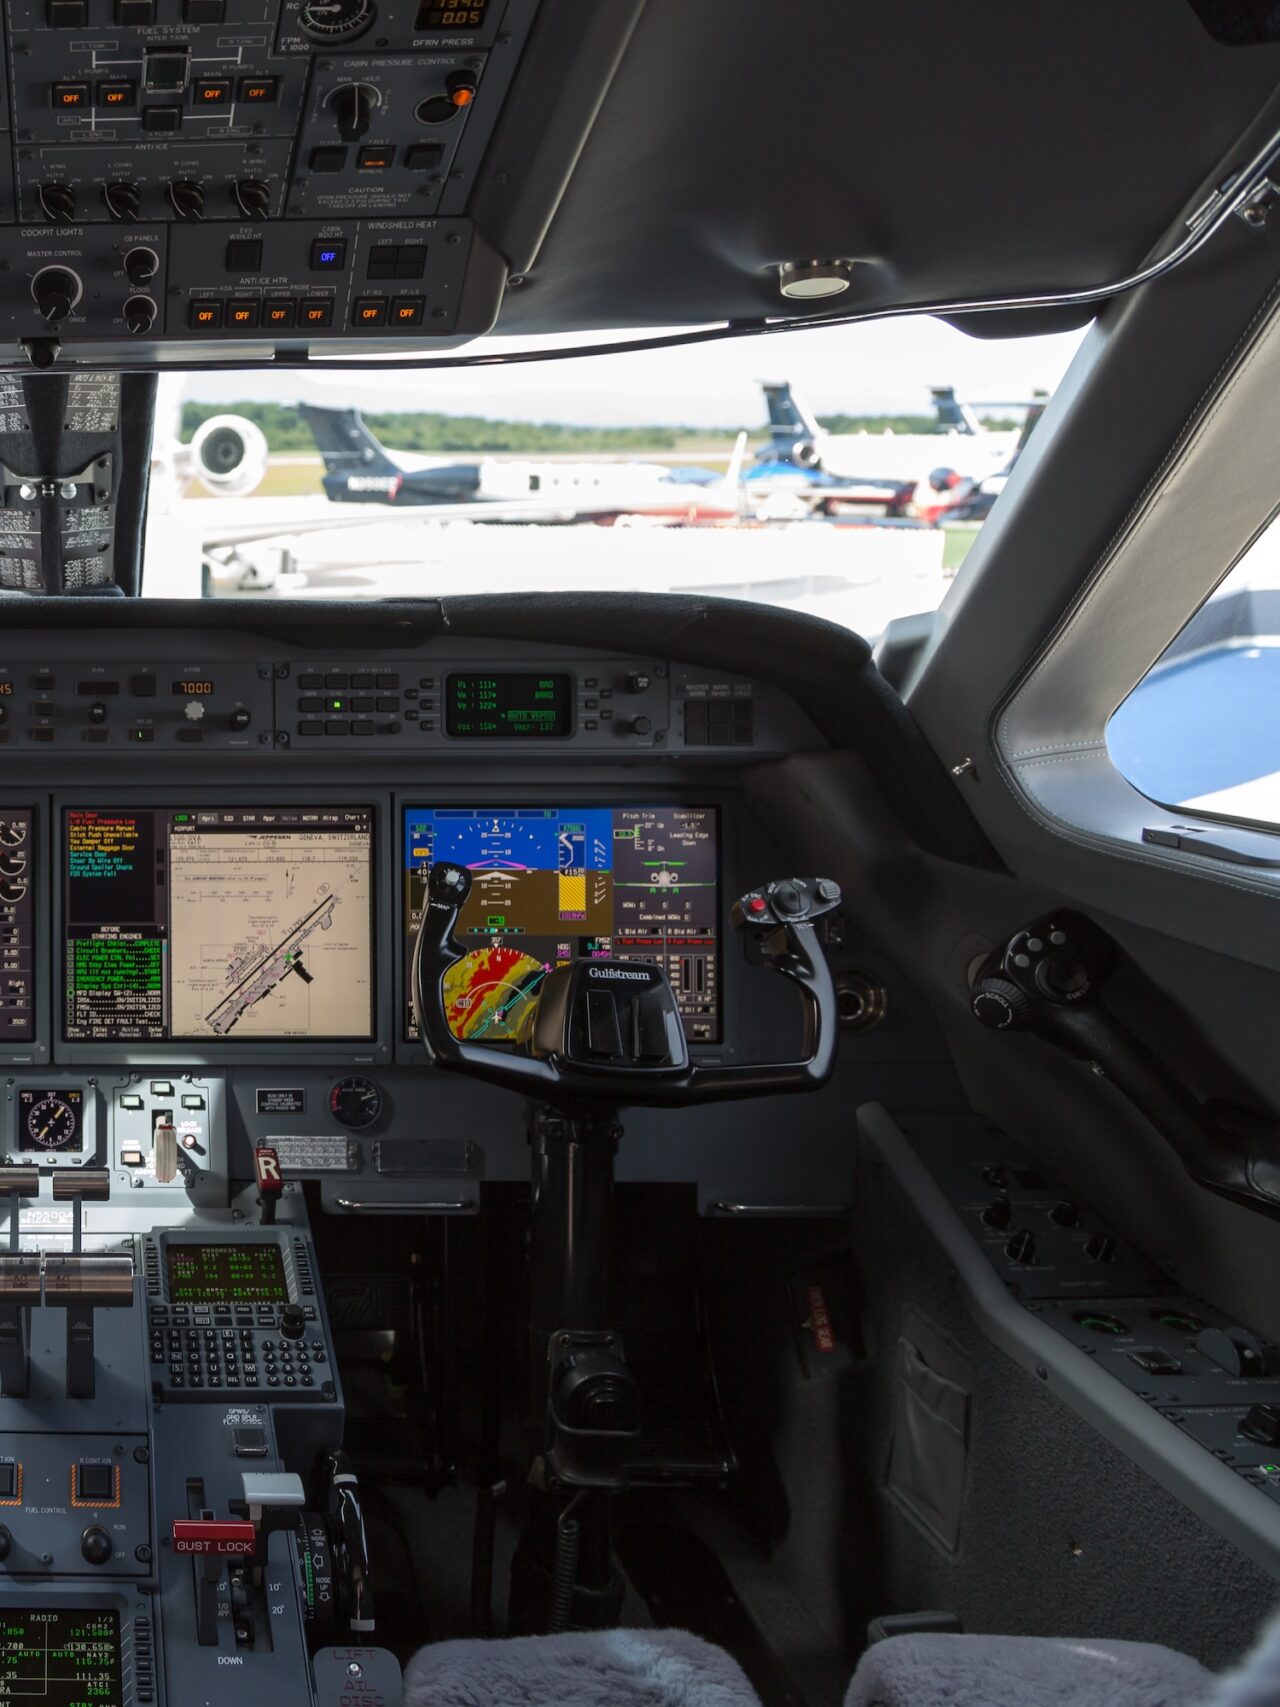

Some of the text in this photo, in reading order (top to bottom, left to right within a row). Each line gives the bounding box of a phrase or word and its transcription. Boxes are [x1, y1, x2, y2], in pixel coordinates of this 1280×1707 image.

[442, 12, 480, 24] 0.05
[107, 94, 125, 102] OFF
[21, 228, 84, 237] COCKPIT LIGHTS
[320, 252, 335, 262] OFF
[199, 312, 213, 321] OFF
[235, 311, 250, 320] OFF
[272, 310, 286, 319] OFF
[308, 310, 323, 319] OFF
[363, 309, 378, 318] OFF
[399, 309, 414, 318] OFF
[180, 681, 212, 695] 7000
[589, 967, 651, 982] Gulfstream
[257, 1156, 280, 1180] R
[177, 1542, 252, 1552] GUST LOCK
[272, 1605, 285, 1615] 20°
[30, 1614, 59, 1622] RADIO
[69, 1643, 110, 1651] 130.650
[332, 1649, 376, 1660] LIFT
[75, 1658, 110, 1666] 115.75
[218, 1656, 243, 1665] DOWN
[76, 1672, 110, 1680] 111.35
[345, 1680, 377, 1692] AIL
[87, 1687, 111, 1696] 2366
[340, 1695, 384, 1707] DISC
